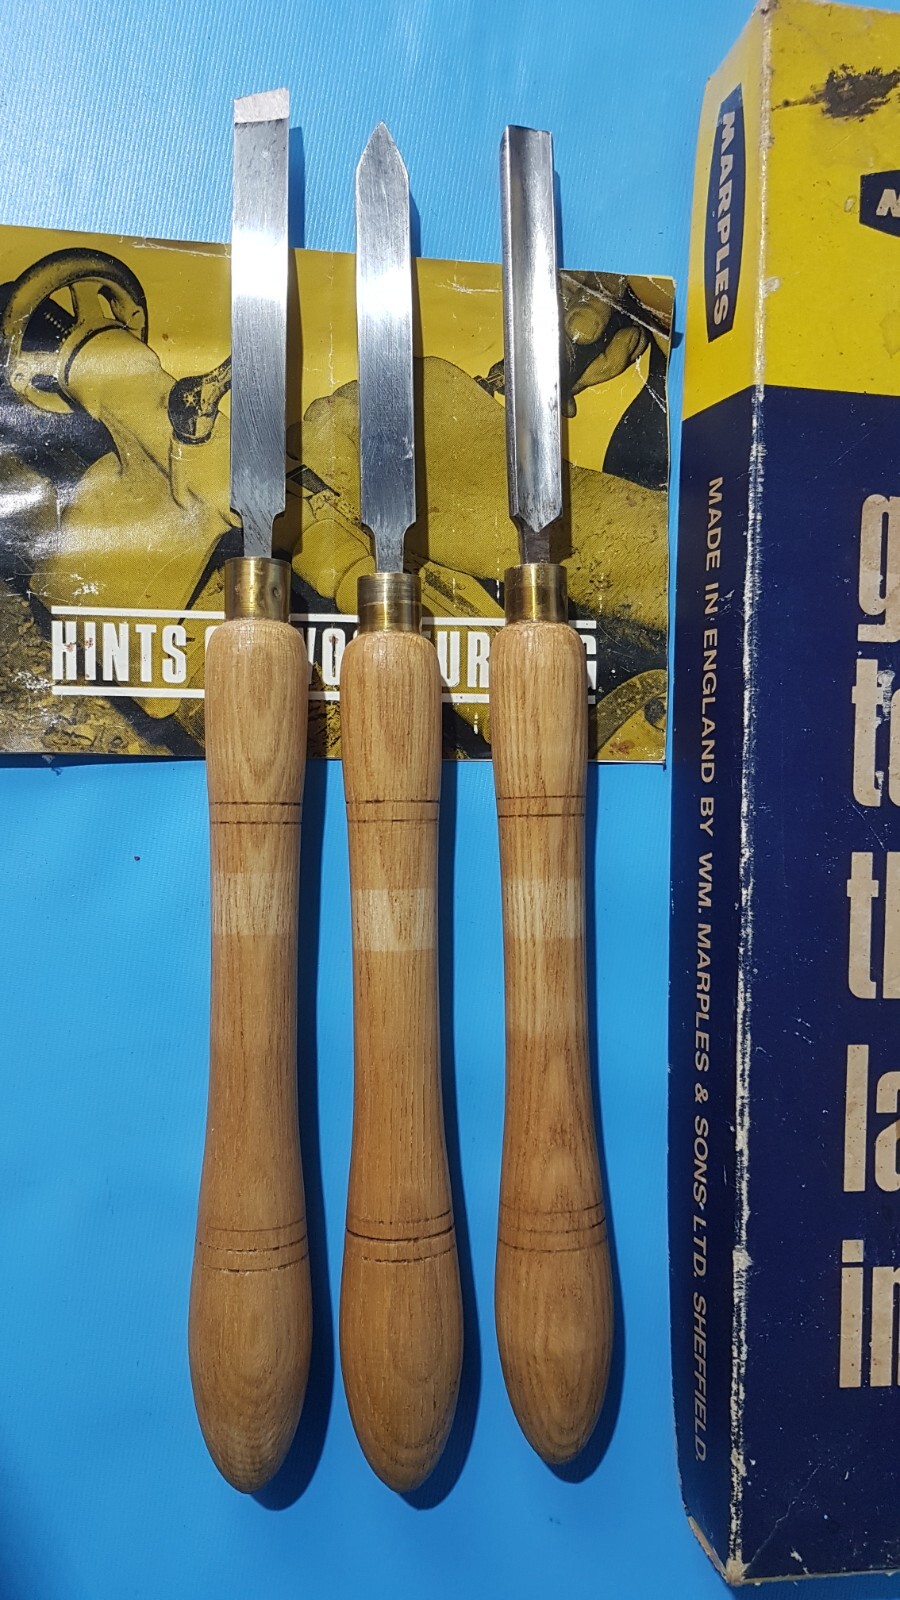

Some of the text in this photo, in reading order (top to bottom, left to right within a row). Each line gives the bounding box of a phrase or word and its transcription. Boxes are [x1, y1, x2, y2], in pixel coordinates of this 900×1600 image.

[714, 111, 736, 326] MARPLES
[706, 476, 723, 571] MADE
[704, 582, 719, 616] IN
[51, 620, 187, 684] HINTS
[701, 628, 718, 784] ENGLAND
[699, 797, 714, 837] BY
[698, 852, 713, 914] WM.
[695, 923, 711, 1072] MARPLES
[694, 1082, 709, 1104] &
[693, 1214, 707, 1278] LTD.
[693, 1291, 707, 1462] SHEFFIELD.
